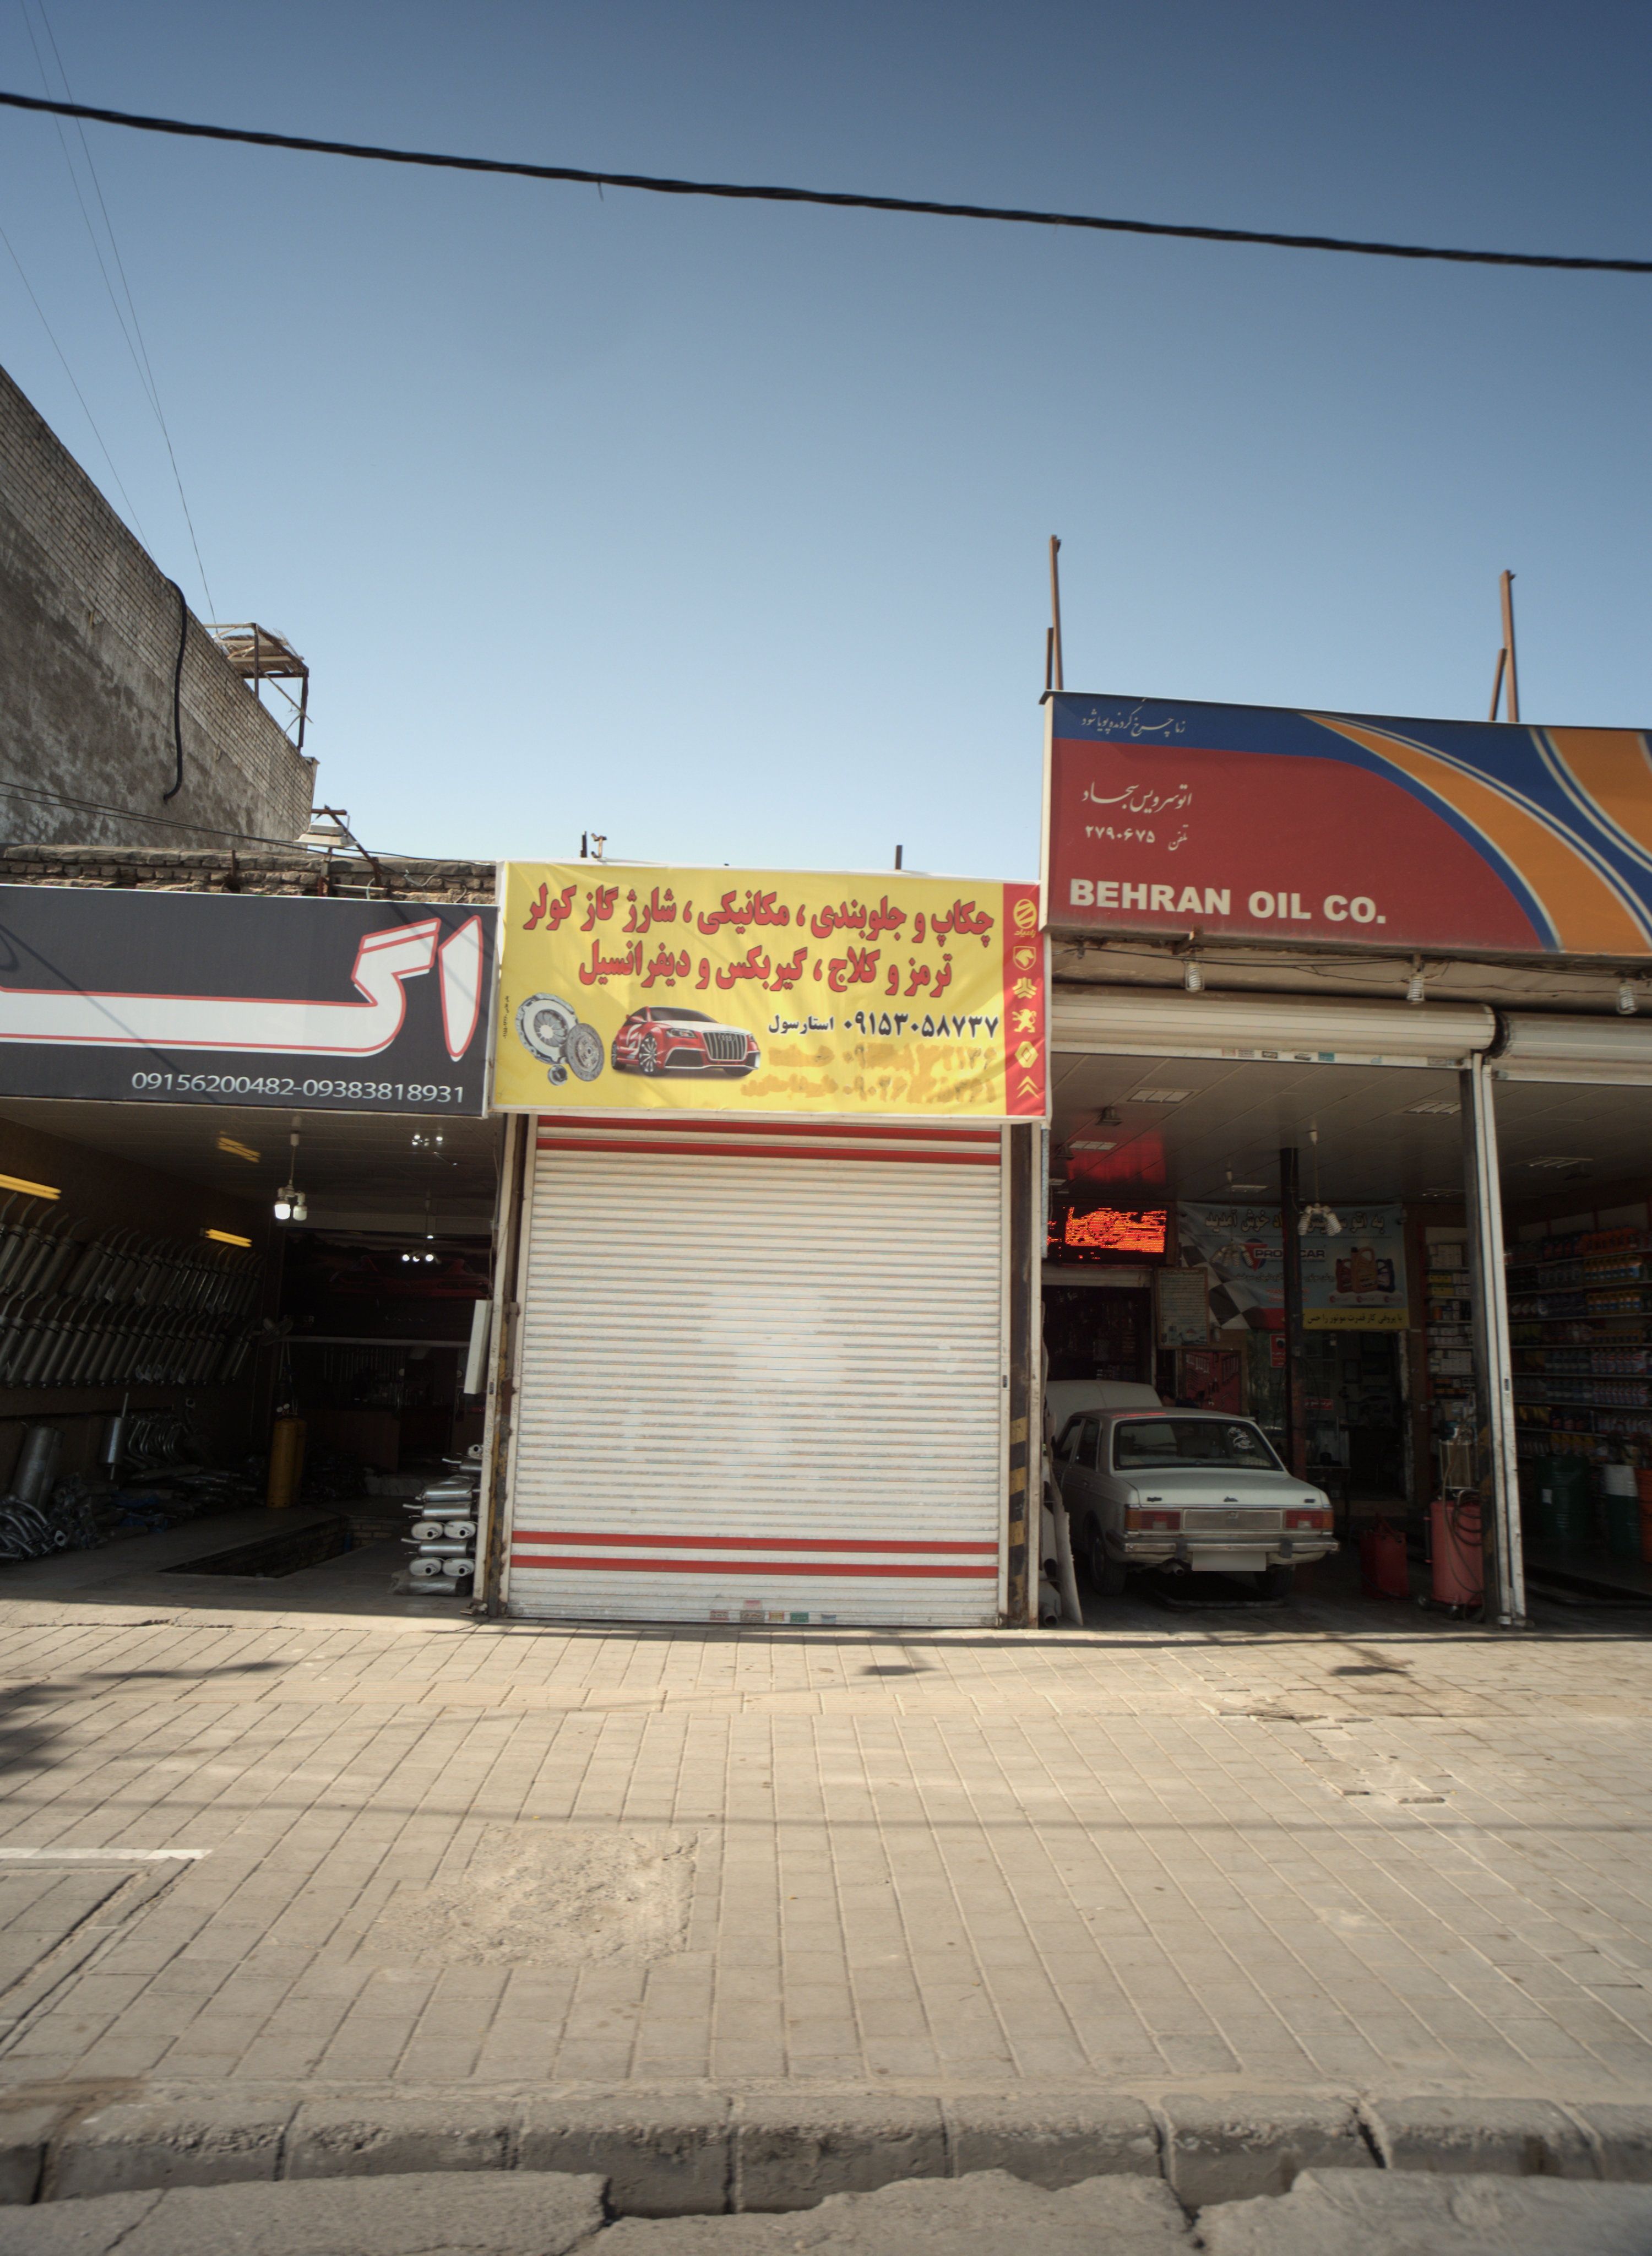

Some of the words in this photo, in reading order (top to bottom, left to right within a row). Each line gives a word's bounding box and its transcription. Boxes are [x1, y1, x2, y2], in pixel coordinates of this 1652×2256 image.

[1081, 708, 1097, 725] شود
[1081, 781, 1139, 810] سجاد
[1168, 825, 1189, 851] تلفن
[523, 882, 577, 930] کولر
[580, 885, 619, 931] گاز
[622, 887, 676, 933] شارژ
[697, 890, 790, 935] مکانیکی
[811, 895, 907, 941] جلوبندی
[1070, 878, 1231, 915] BEHRAN
[1248, 891, 1311, 919] OIL
[1323, 894, 1386, 924] CO.
[912, 912, 926, 943] و
[931, 899, 995, 948] چکاپ
[579, 938, 691, 988] دیفرانسیل
[695, 958, 710, 989] و
[715, 945, 808, 991] گیربکس
[828, 946, 881, 993] کلاج
[885, 964, 899, 996] و
[904, 953, 953, 997] ترمز
[843, 1011, 999, 1038] ۰۹۱۵۳۰۵۸۷۳۷
[1205, 1210, 1237, 1233] آمدید
[1241, 1209, 1270, 1233] خوش
